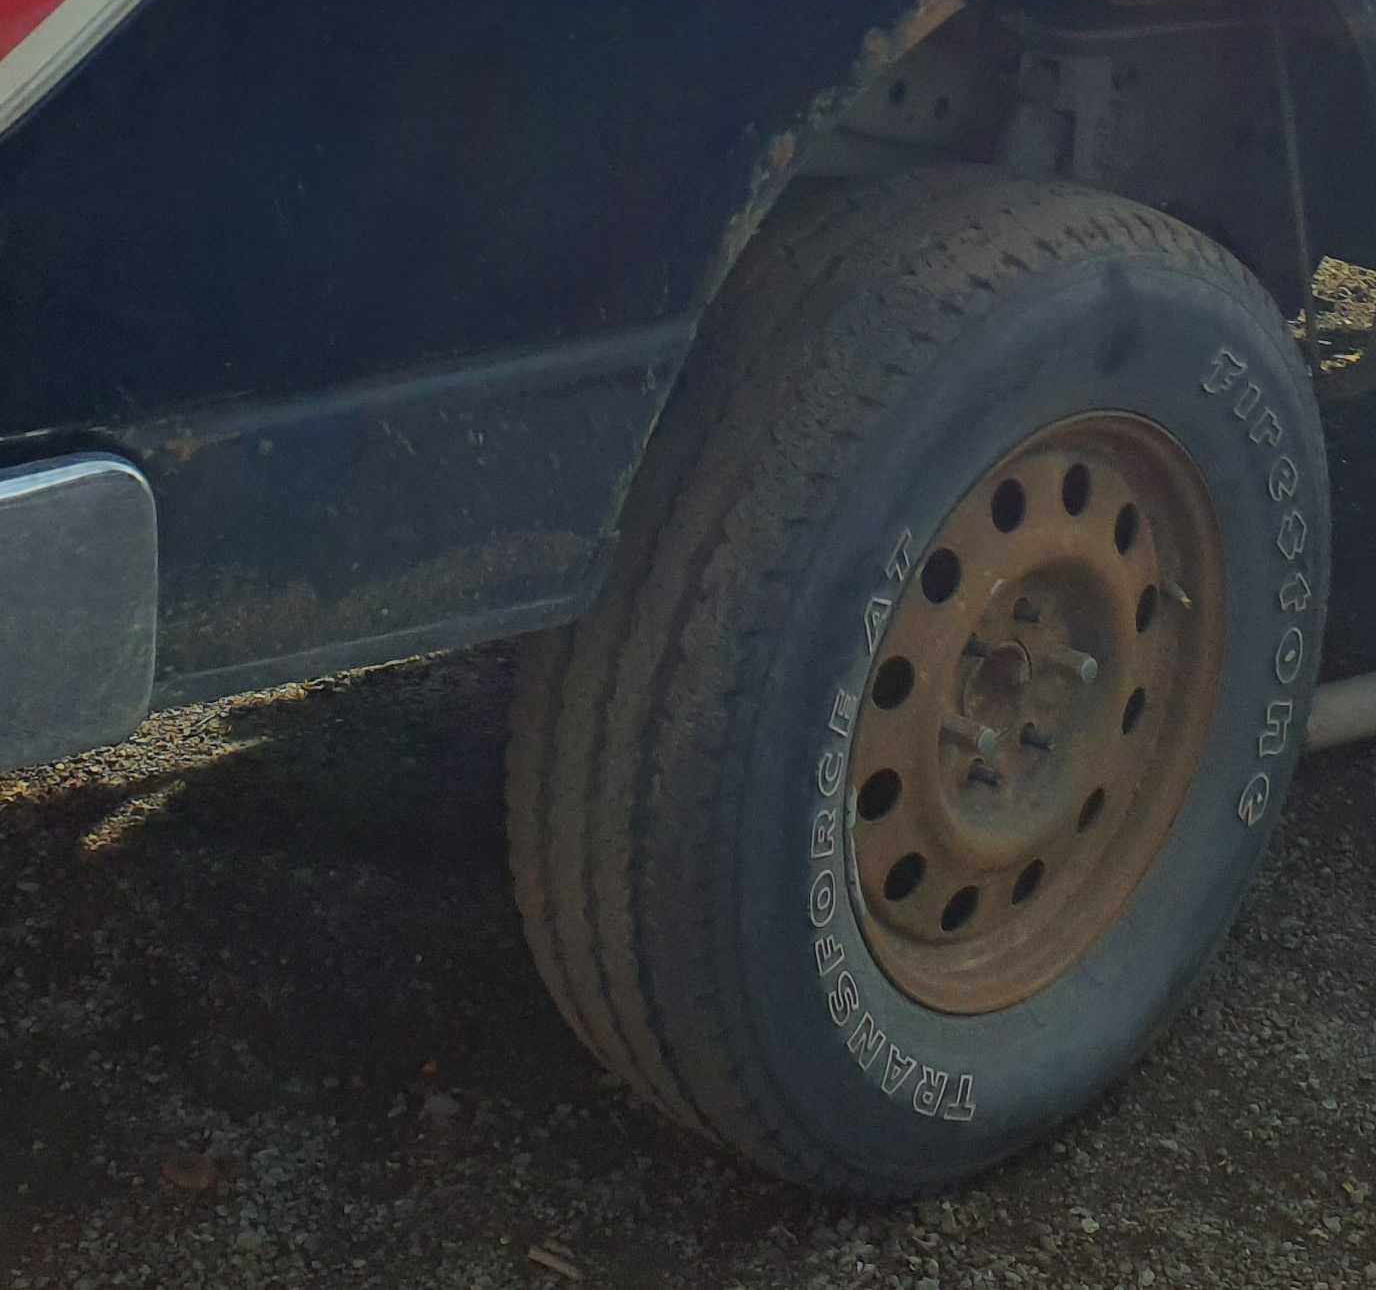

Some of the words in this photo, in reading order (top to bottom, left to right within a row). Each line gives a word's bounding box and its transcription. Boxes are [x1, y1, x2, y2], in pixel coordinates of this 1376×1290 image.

[865, 529, 914, 657] AT
[1203, 350, 1311, 827] Firestone
[810, 690, 978, 1123] TRANSFORCE
